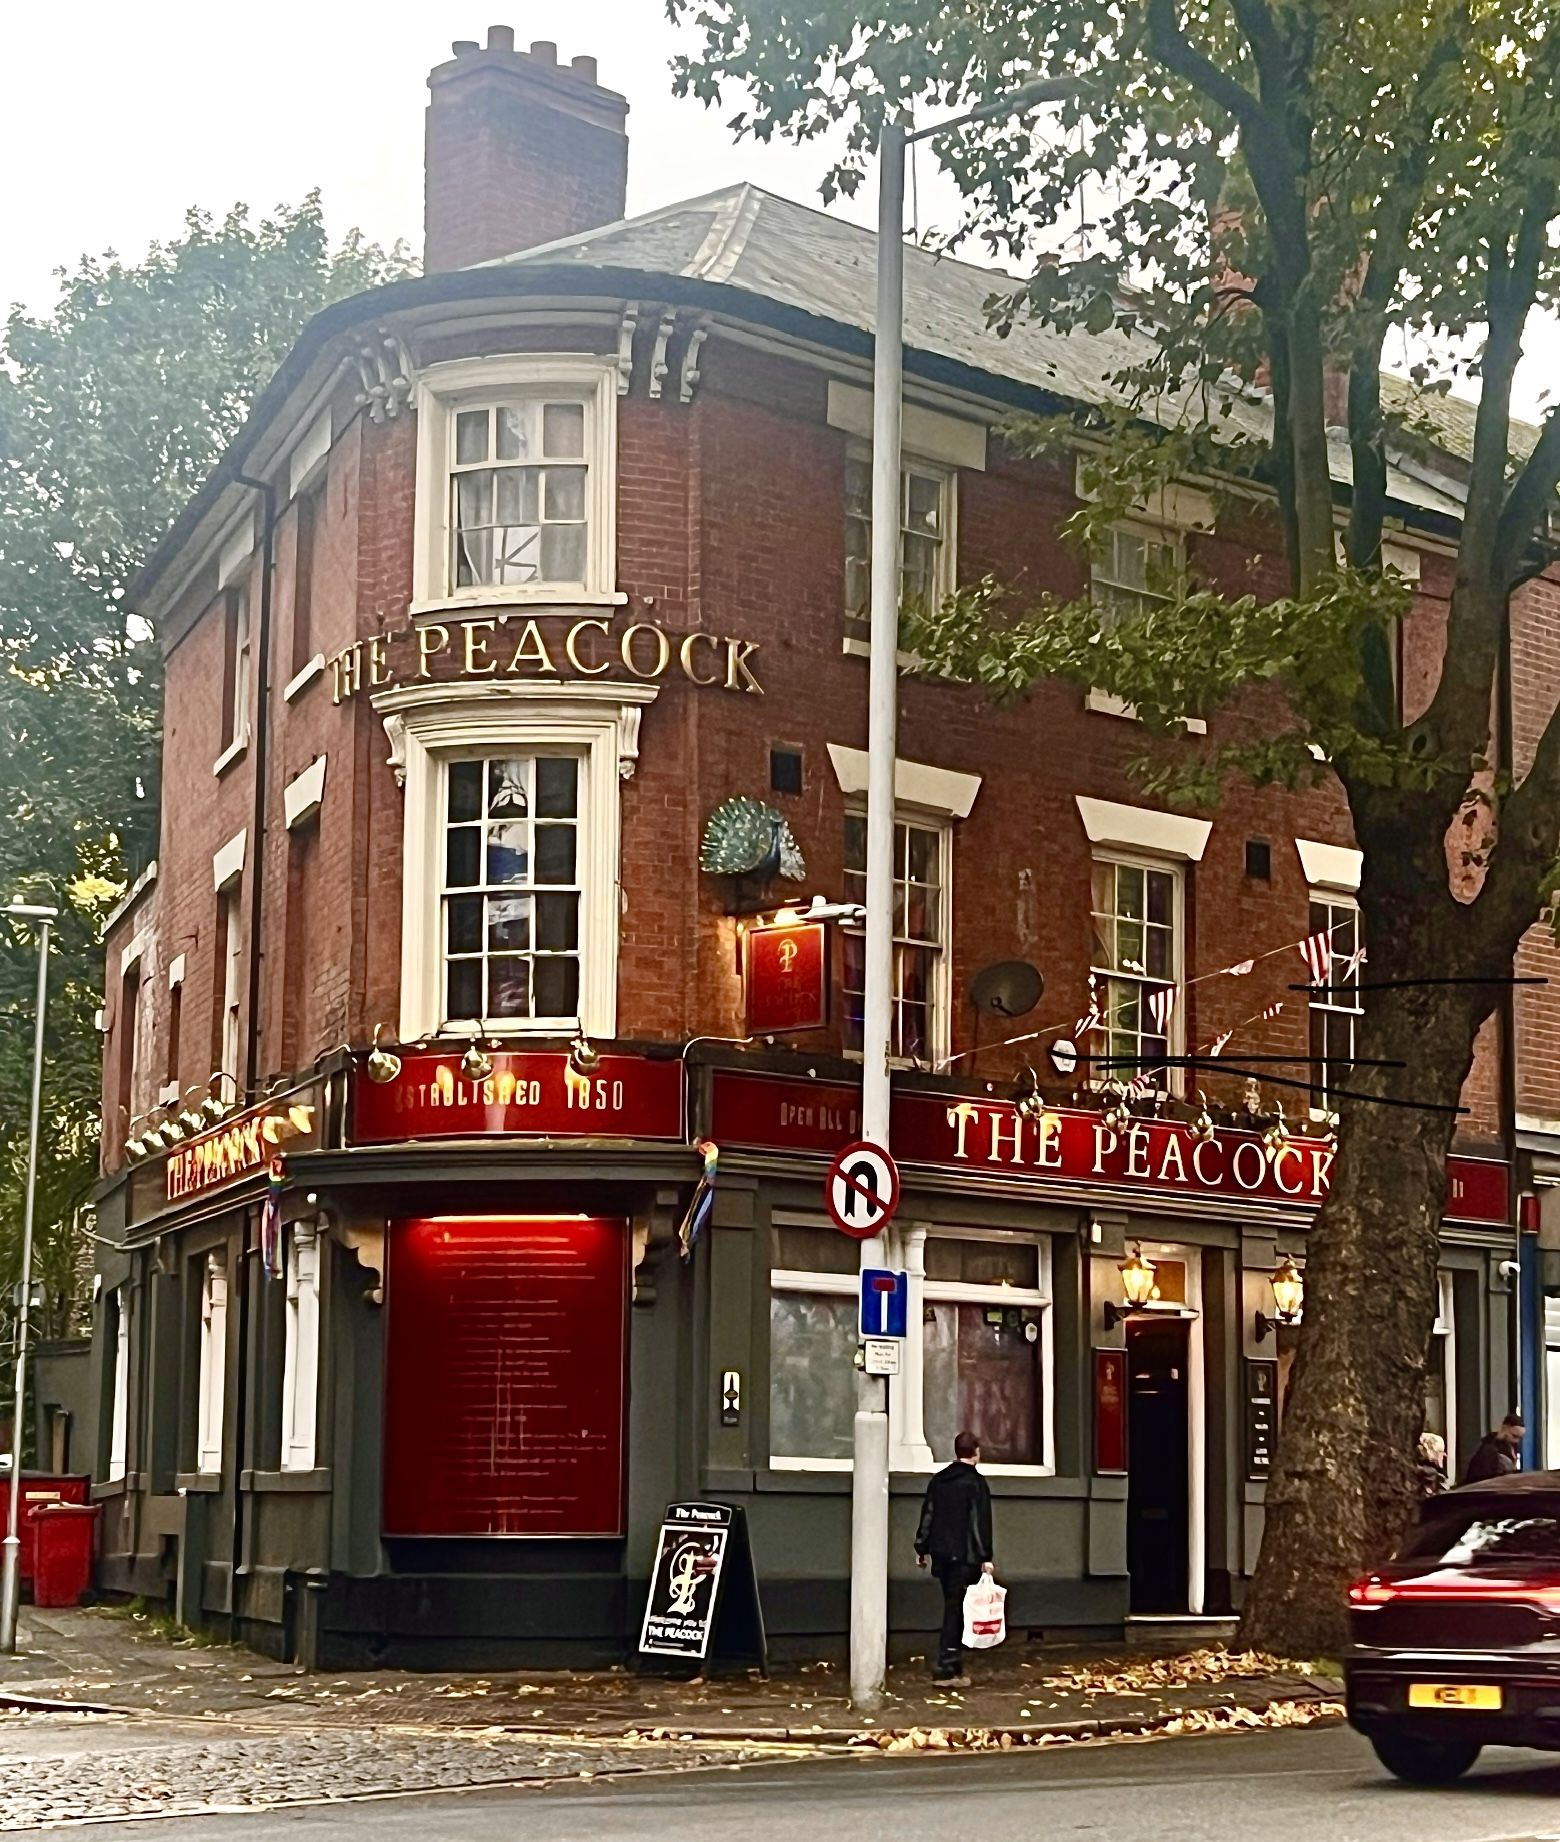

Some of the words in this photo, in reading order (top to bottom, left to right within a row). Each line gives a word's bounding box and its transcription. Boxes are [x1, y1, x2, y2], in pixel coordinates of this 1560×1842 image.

[326, 632, 393, 703] THE
[415, 619, 765, 695] PEACOCK
[567, 1079, 623, 1110] 1850
[947, 1106, 1062, 1168] THE
[1091, 1124, 1334, 1196] PEACOCK
